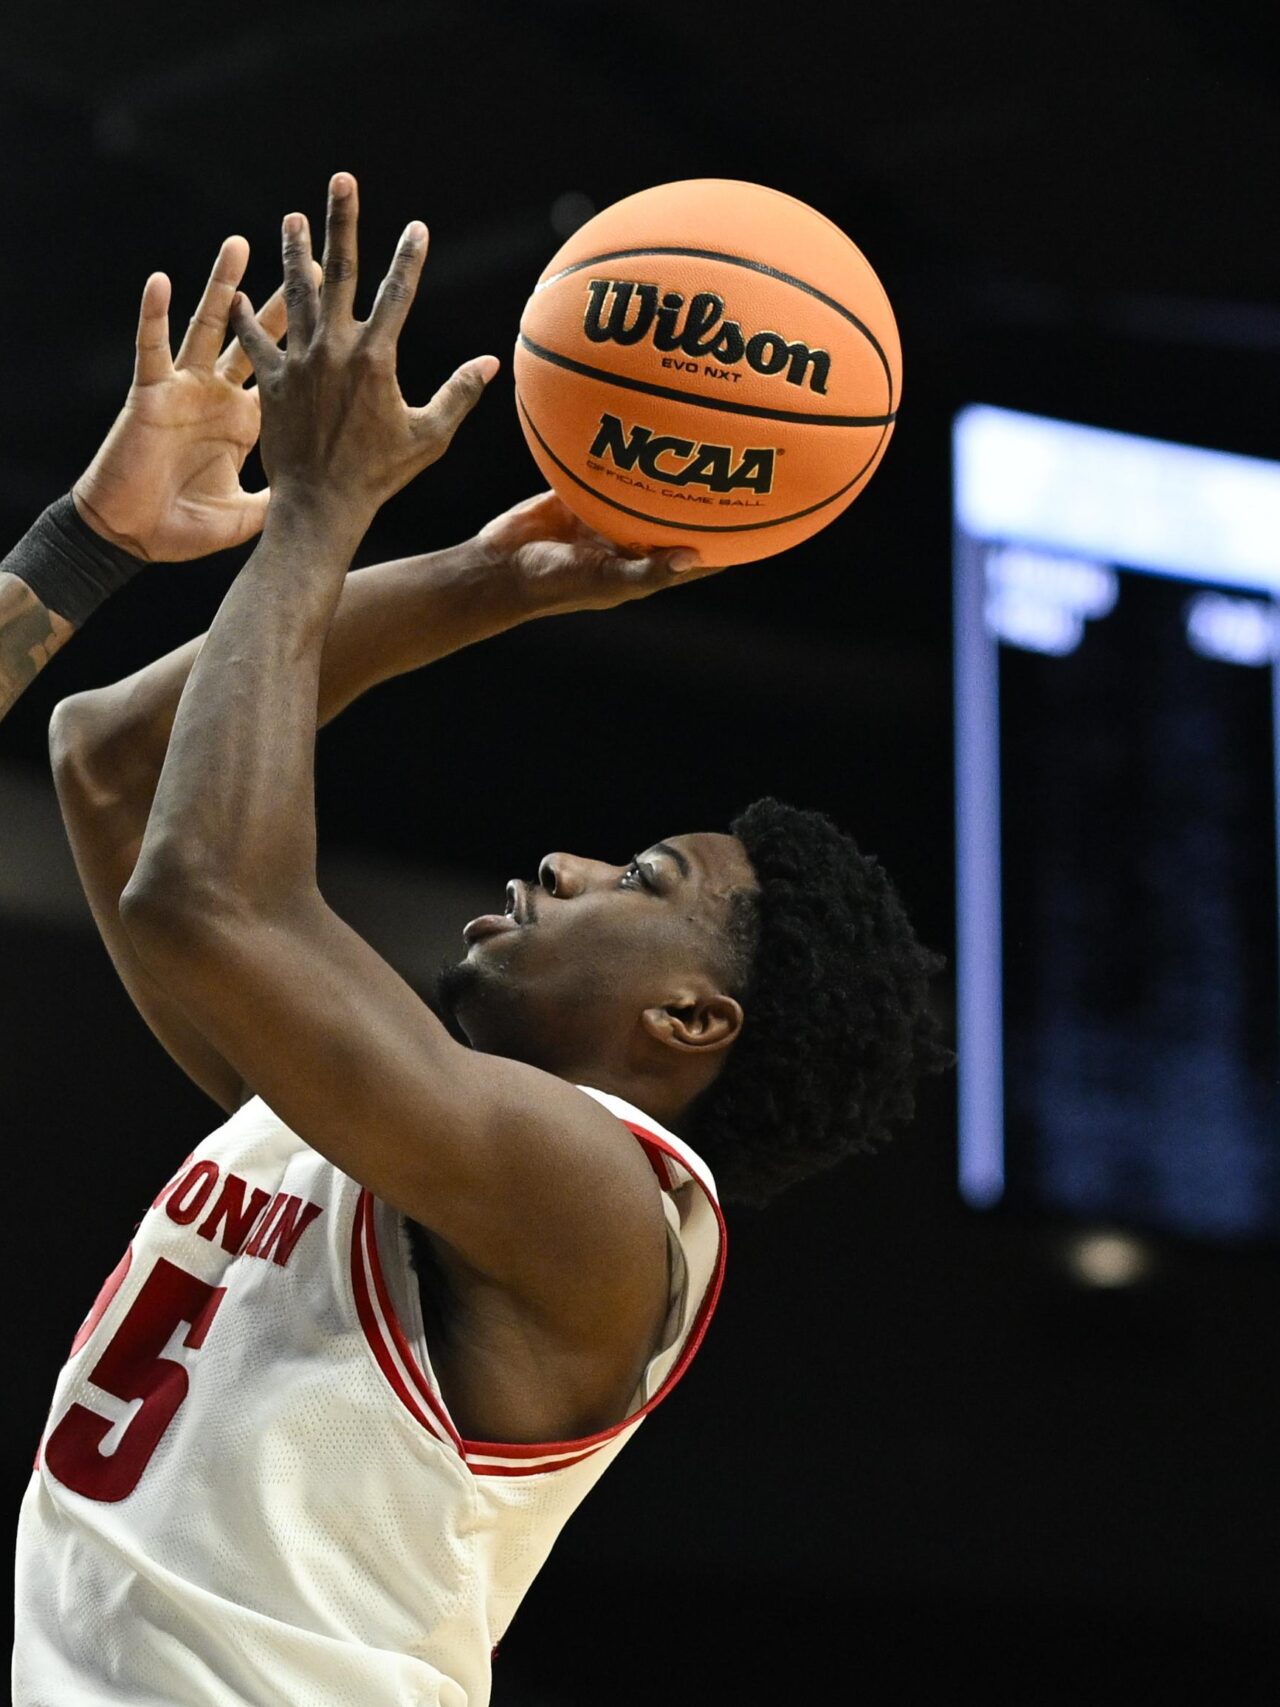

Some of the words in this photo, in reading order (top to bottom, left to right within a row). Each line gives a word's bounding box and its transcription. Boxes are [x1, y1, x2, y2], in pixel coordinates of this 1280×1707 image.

[583, 278, 832, 396] Wilson
[661, 357, 699, 374] EVO
[704, 365, 743, 383] NXT
[586, 460, 657, 493] OFFICIAL
[661, 488, 714, 505] GAME
[718, 499, 766, 507] BALL
[588, 413, 776, 495] NCAA
[34, 1244, 228, 1503] 5
